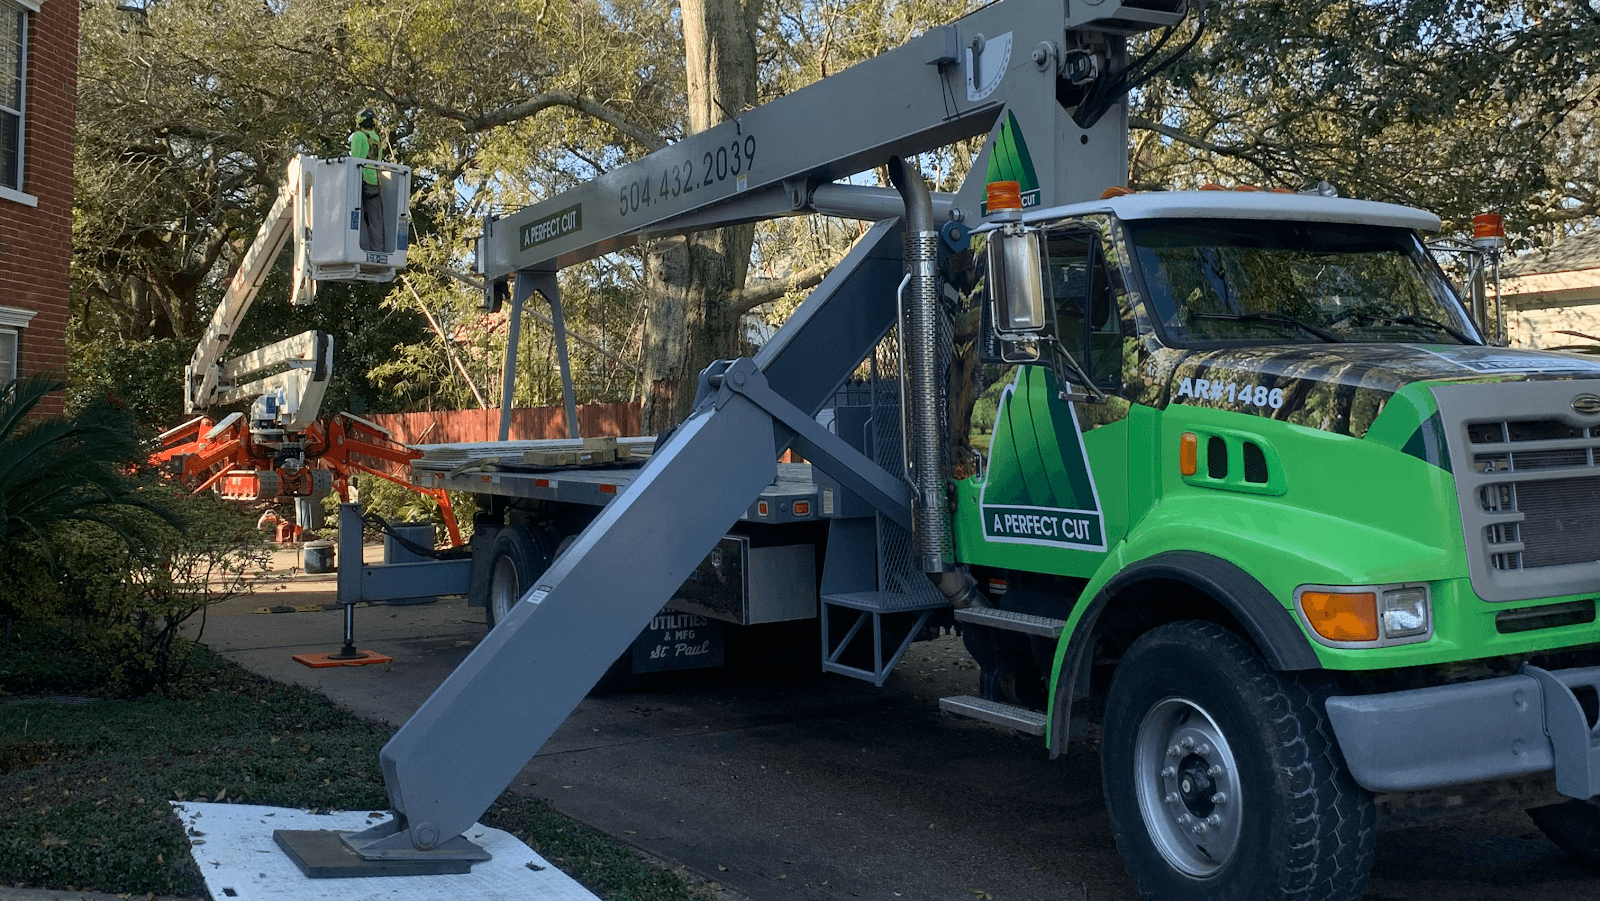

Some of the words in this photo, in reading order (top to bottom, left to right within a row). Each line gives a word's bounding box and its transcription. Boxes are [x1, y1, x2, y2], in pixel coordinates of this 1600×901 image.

[619, 135, 756, 217] 504.432.2039
[1021, 194, 1036, 207] CUT
[524, 229, 531, 246] A
[531, 217, 561, 242] PERFECT
[561, 211, 577, 232] CUT
[1178, 377, 1284, 409] AR#1486
[993, 513, 1004, 533] A
[1005, 514, 1058, 536] PERFECT
[1062, 518, 1090, 540] CUT
[650, 613, 708, 631] UTILITIES
[664, 631, 672, 641] &
[675, 630, 696, 640] MFG
[674, 640, 710, 657] Paul
